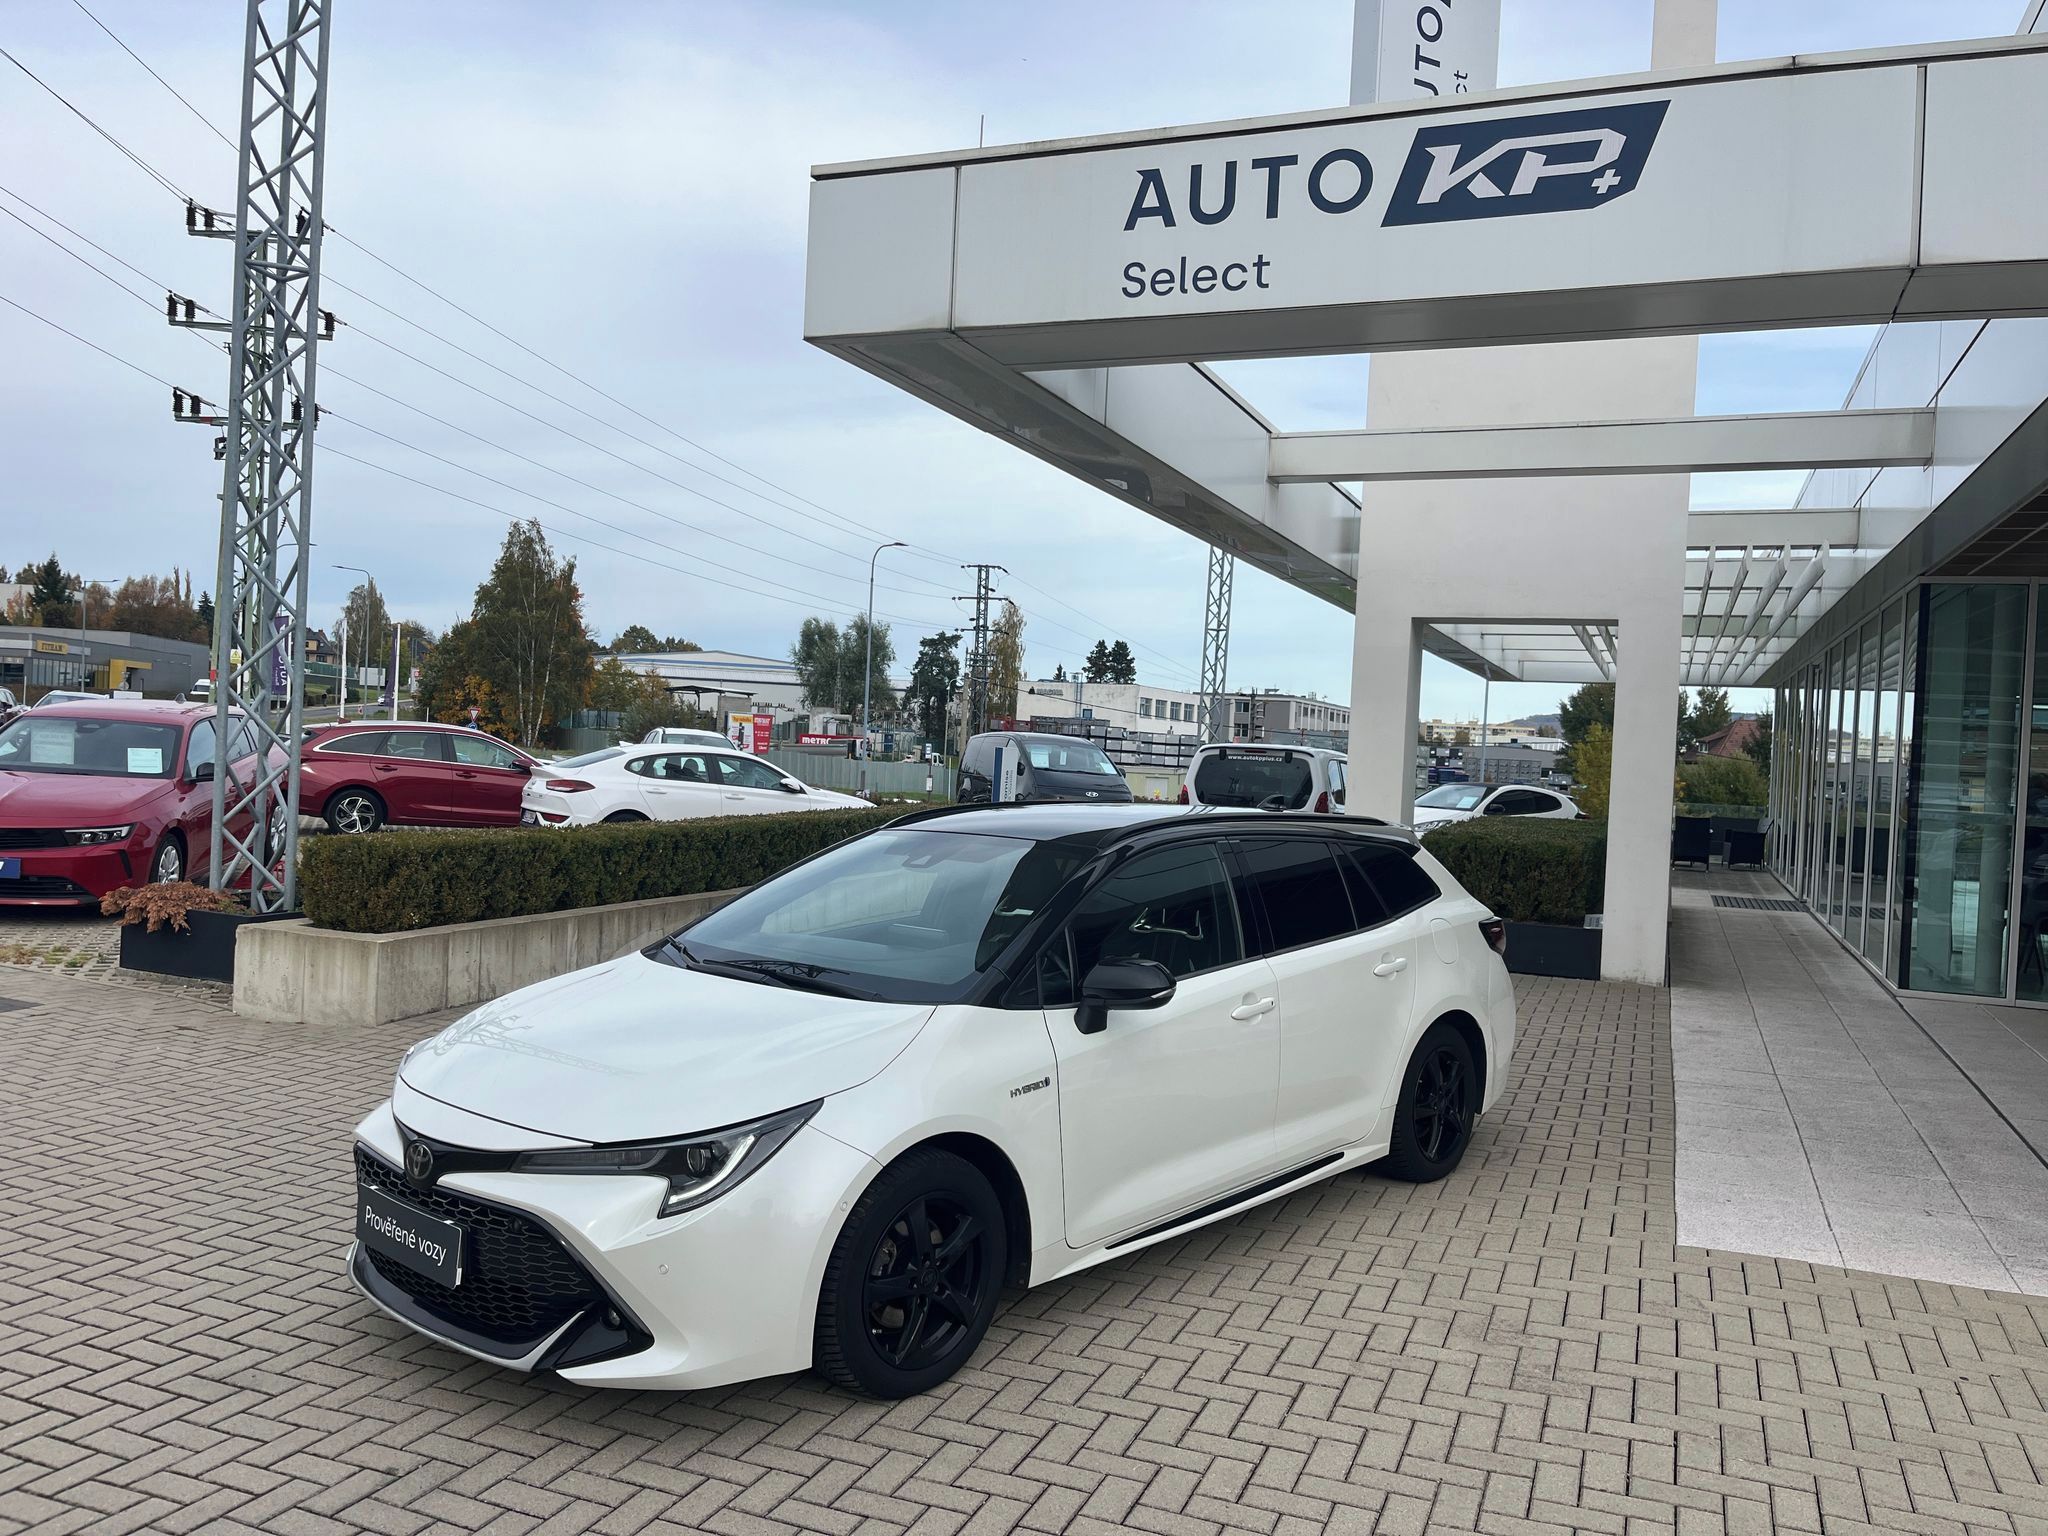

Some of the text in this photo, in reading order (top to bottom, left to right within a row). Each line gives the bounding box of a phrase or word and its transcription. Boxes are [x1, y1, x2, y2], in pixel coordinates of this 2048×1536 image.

[1123, 148, 1374, 231] AUTO
[1121, 254, 1271, 298] Select
[1010, 1080, 1045, 1098] HYBRID
[365, 1205, 447, 1267] Prověřené vozy
